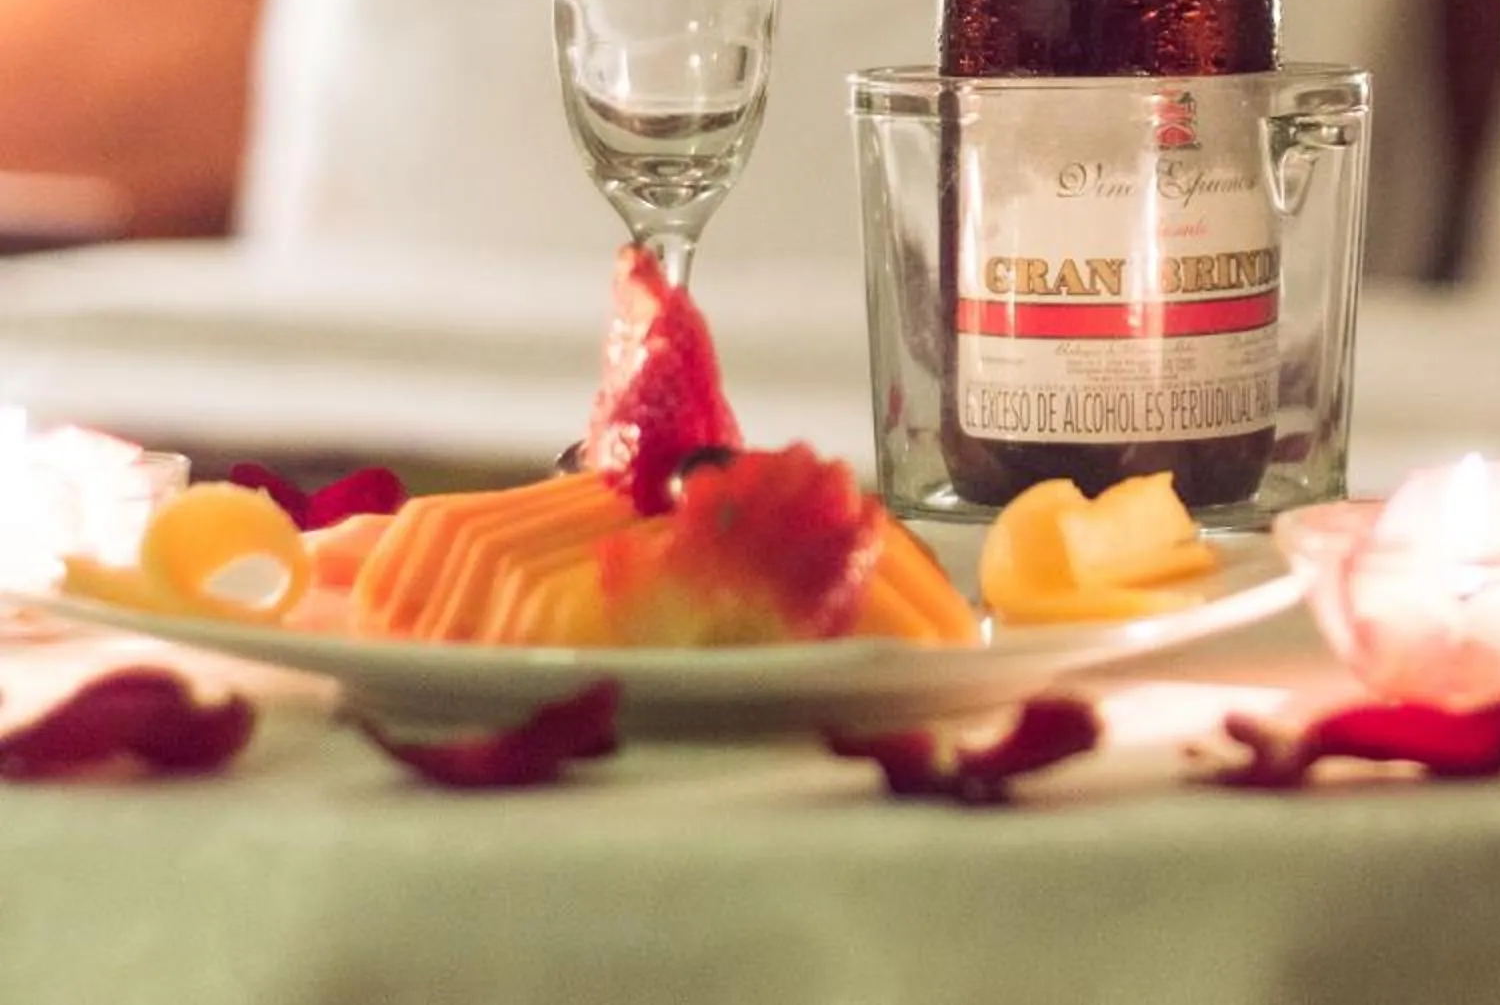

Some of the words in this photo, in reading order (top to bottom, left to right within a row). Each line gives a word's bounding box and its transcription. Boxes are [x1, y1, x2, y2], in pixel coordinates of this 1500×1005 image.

[985, 257, 1124, 296] GRAN
[981, 389, 1031, 432] EXCESO
[1037, 392, 1057, 434] DE
[1063, 392, 1140, 434] ALCOHOL
[1145, 391, 1165, 432] ES
[1171, 386, 1252, 431] PERJUDICIAL
